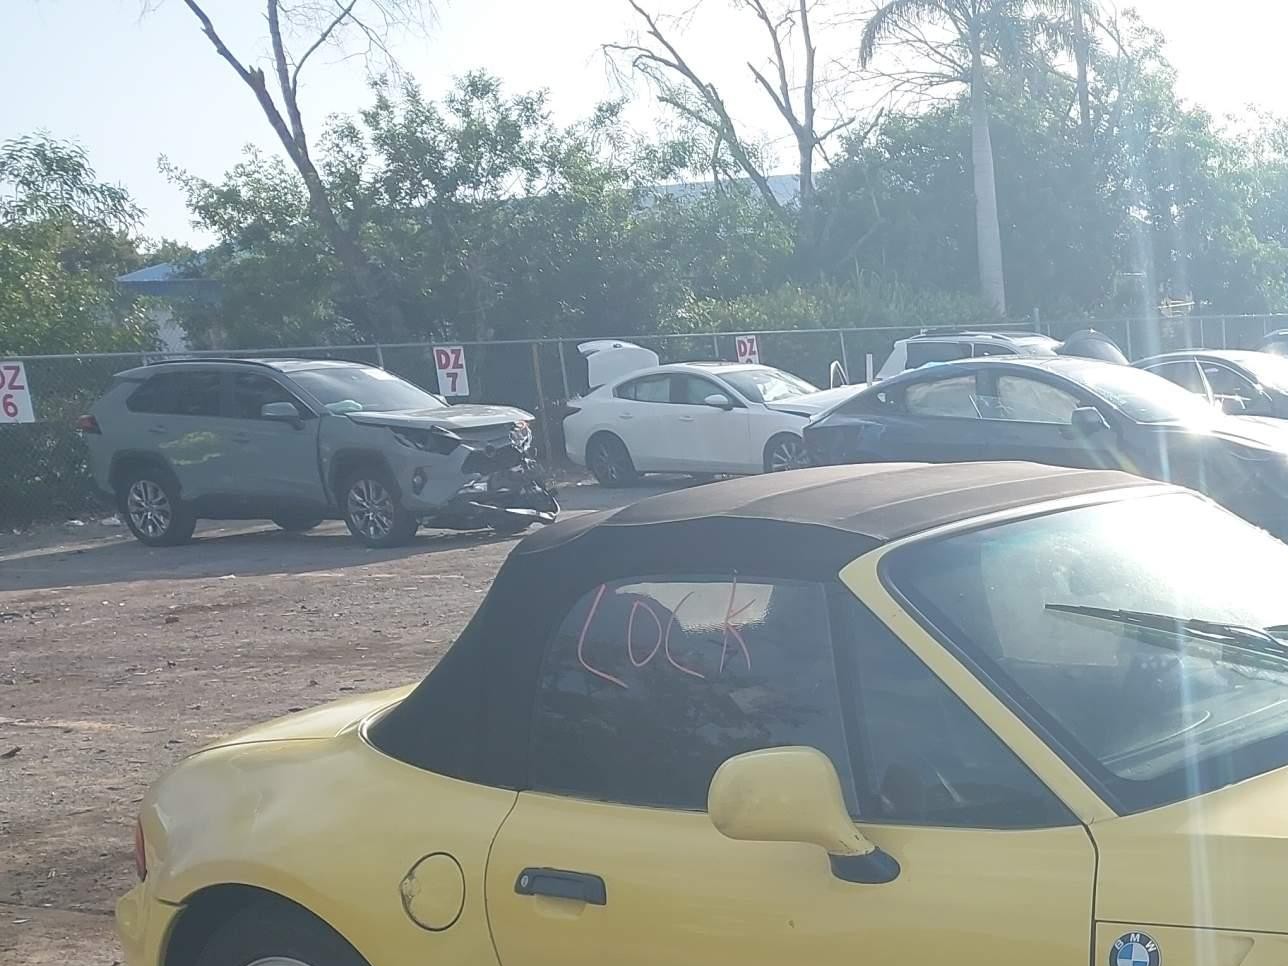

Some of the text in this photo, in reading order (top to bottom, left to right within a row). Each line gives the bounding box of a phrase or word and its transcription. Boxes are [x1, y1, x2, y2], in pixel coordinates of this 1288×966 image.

[737, 339, 756, 357] DZ
[436, 349, 464, 369] DZ
[446, 372, 458, 392] 7
[3, 394, 18, 417] 6
[578, 575, 756, 688] LOCK
[1114, 933, 1157, 952] BMW
